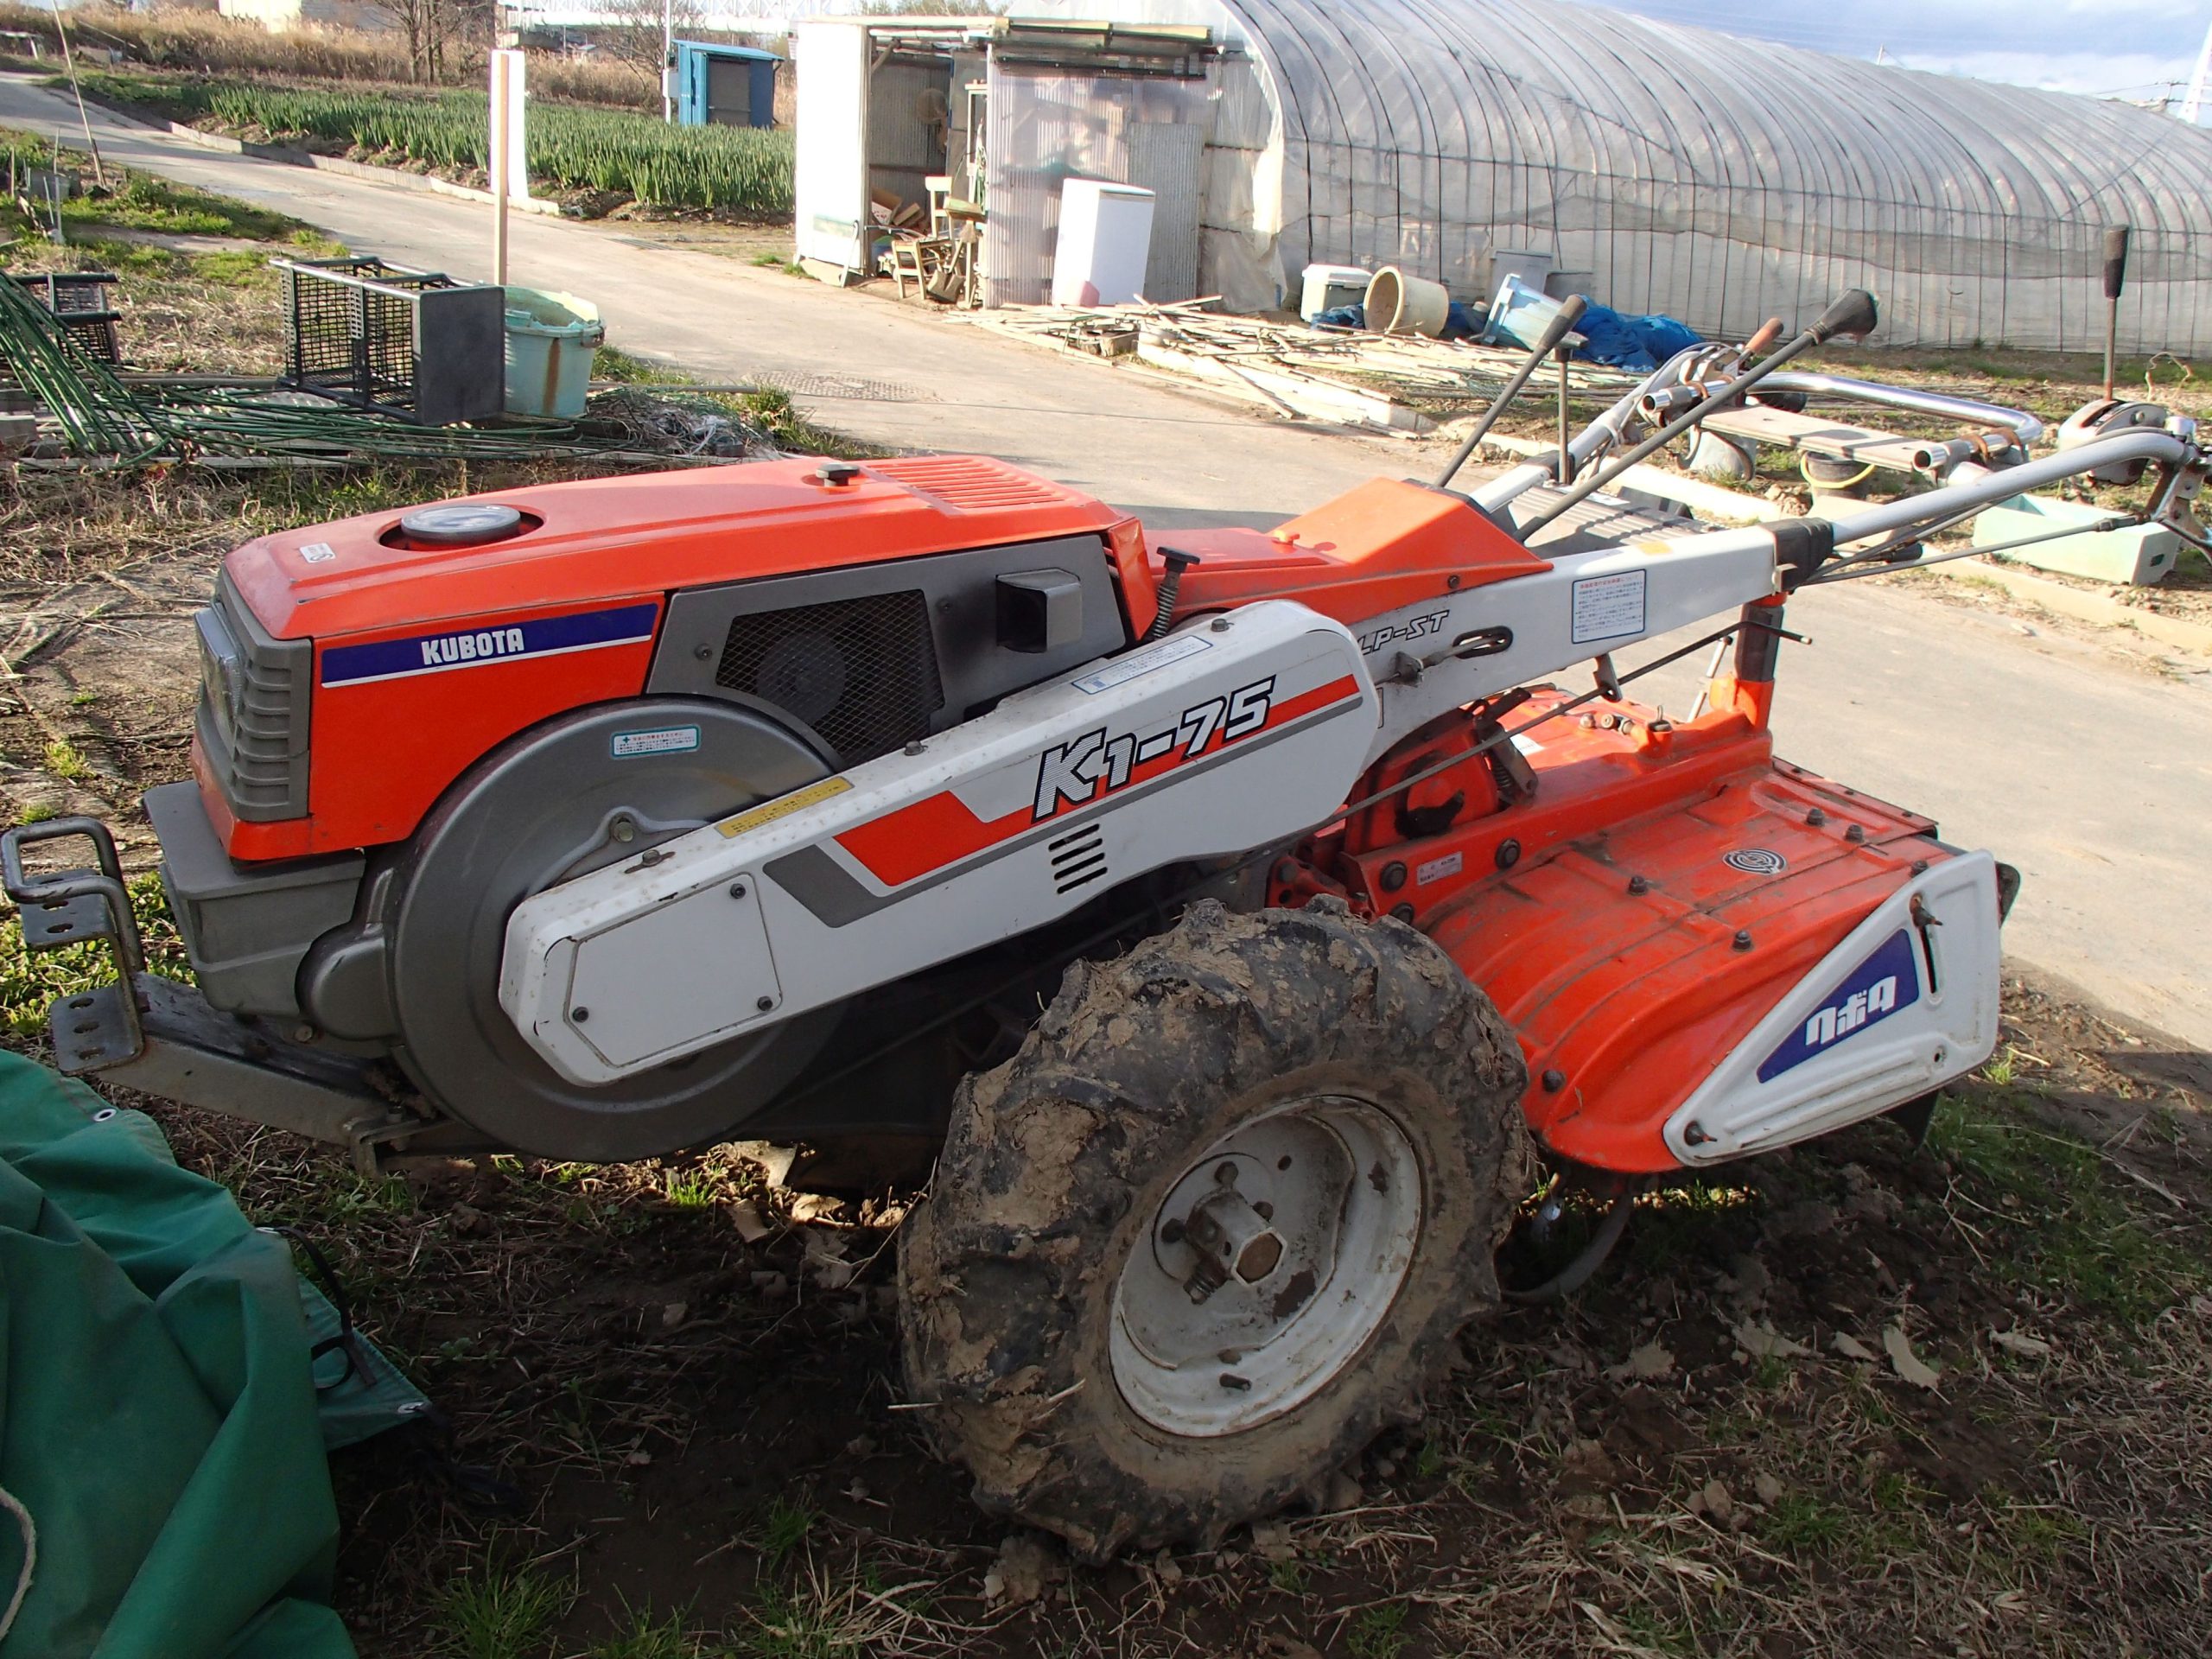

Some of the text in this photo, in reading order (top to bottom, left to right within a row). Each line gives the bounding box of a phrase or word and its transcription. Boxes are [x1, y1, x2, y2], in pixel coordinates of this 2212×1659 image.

[421, 627, 524, 665] KUBOTA
[1032, 674, 1276, 823] K1-75
[1805, 976, 1897, 1047] クボタ
